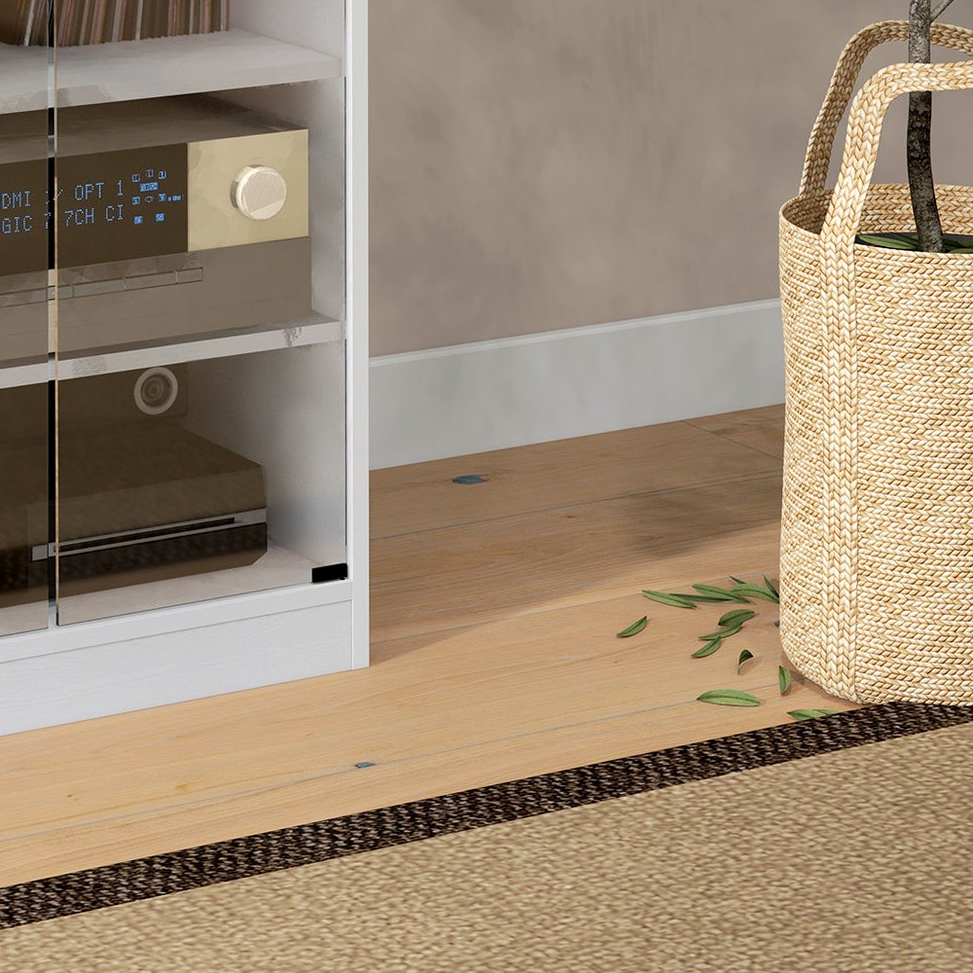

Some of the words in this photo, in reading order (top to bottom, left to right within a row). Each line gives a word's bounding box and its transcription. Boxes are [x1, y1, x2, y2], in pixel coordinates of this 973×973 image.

[74, 182, 104, 201] OPT
[64, 207, 95, 227] 7CH
[105, 204, 123, 222] CI
